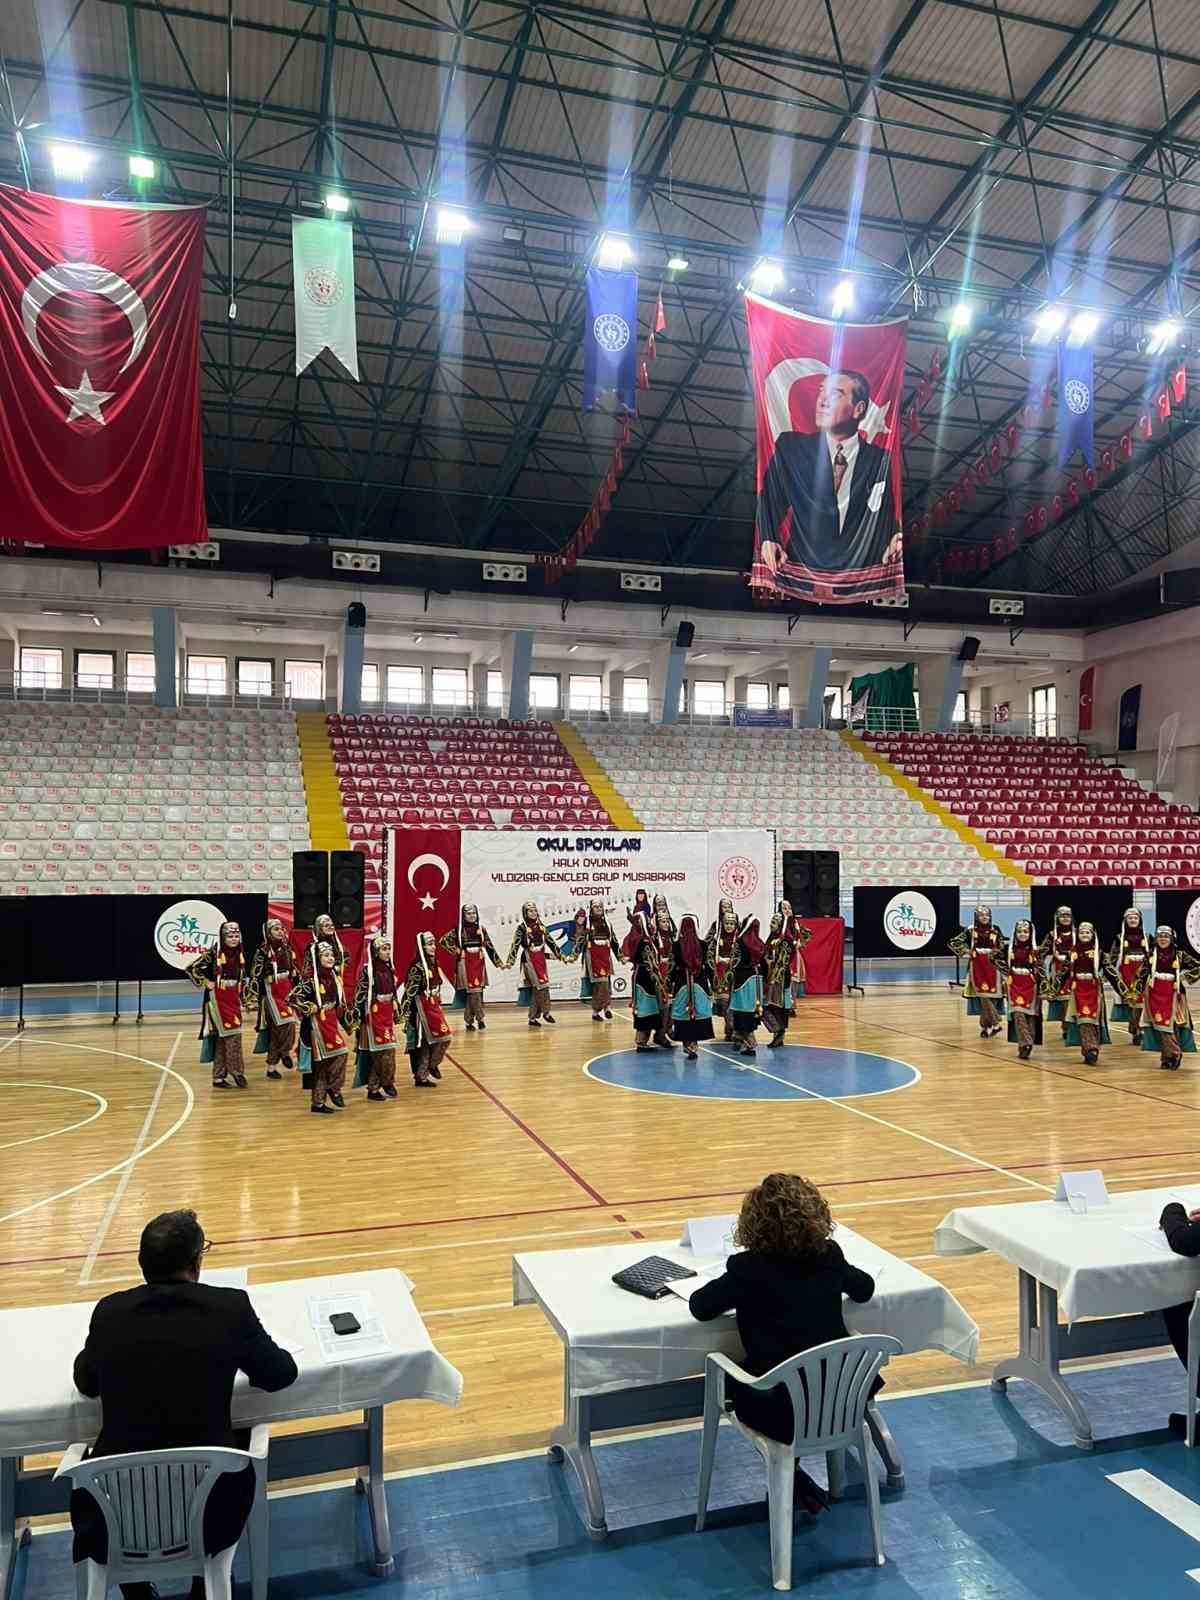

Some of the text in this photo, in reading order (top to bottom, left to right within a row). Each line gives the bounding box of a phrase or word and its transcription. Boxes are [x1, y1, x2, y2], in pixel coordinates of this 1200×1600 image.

[536, 837, 642, 852] OKUL SPORLARI
[552, 858, 580, 868] HALK
[592, 872, 620, 881] GRUP
[569, 886, 612, 896] YOZGAT
